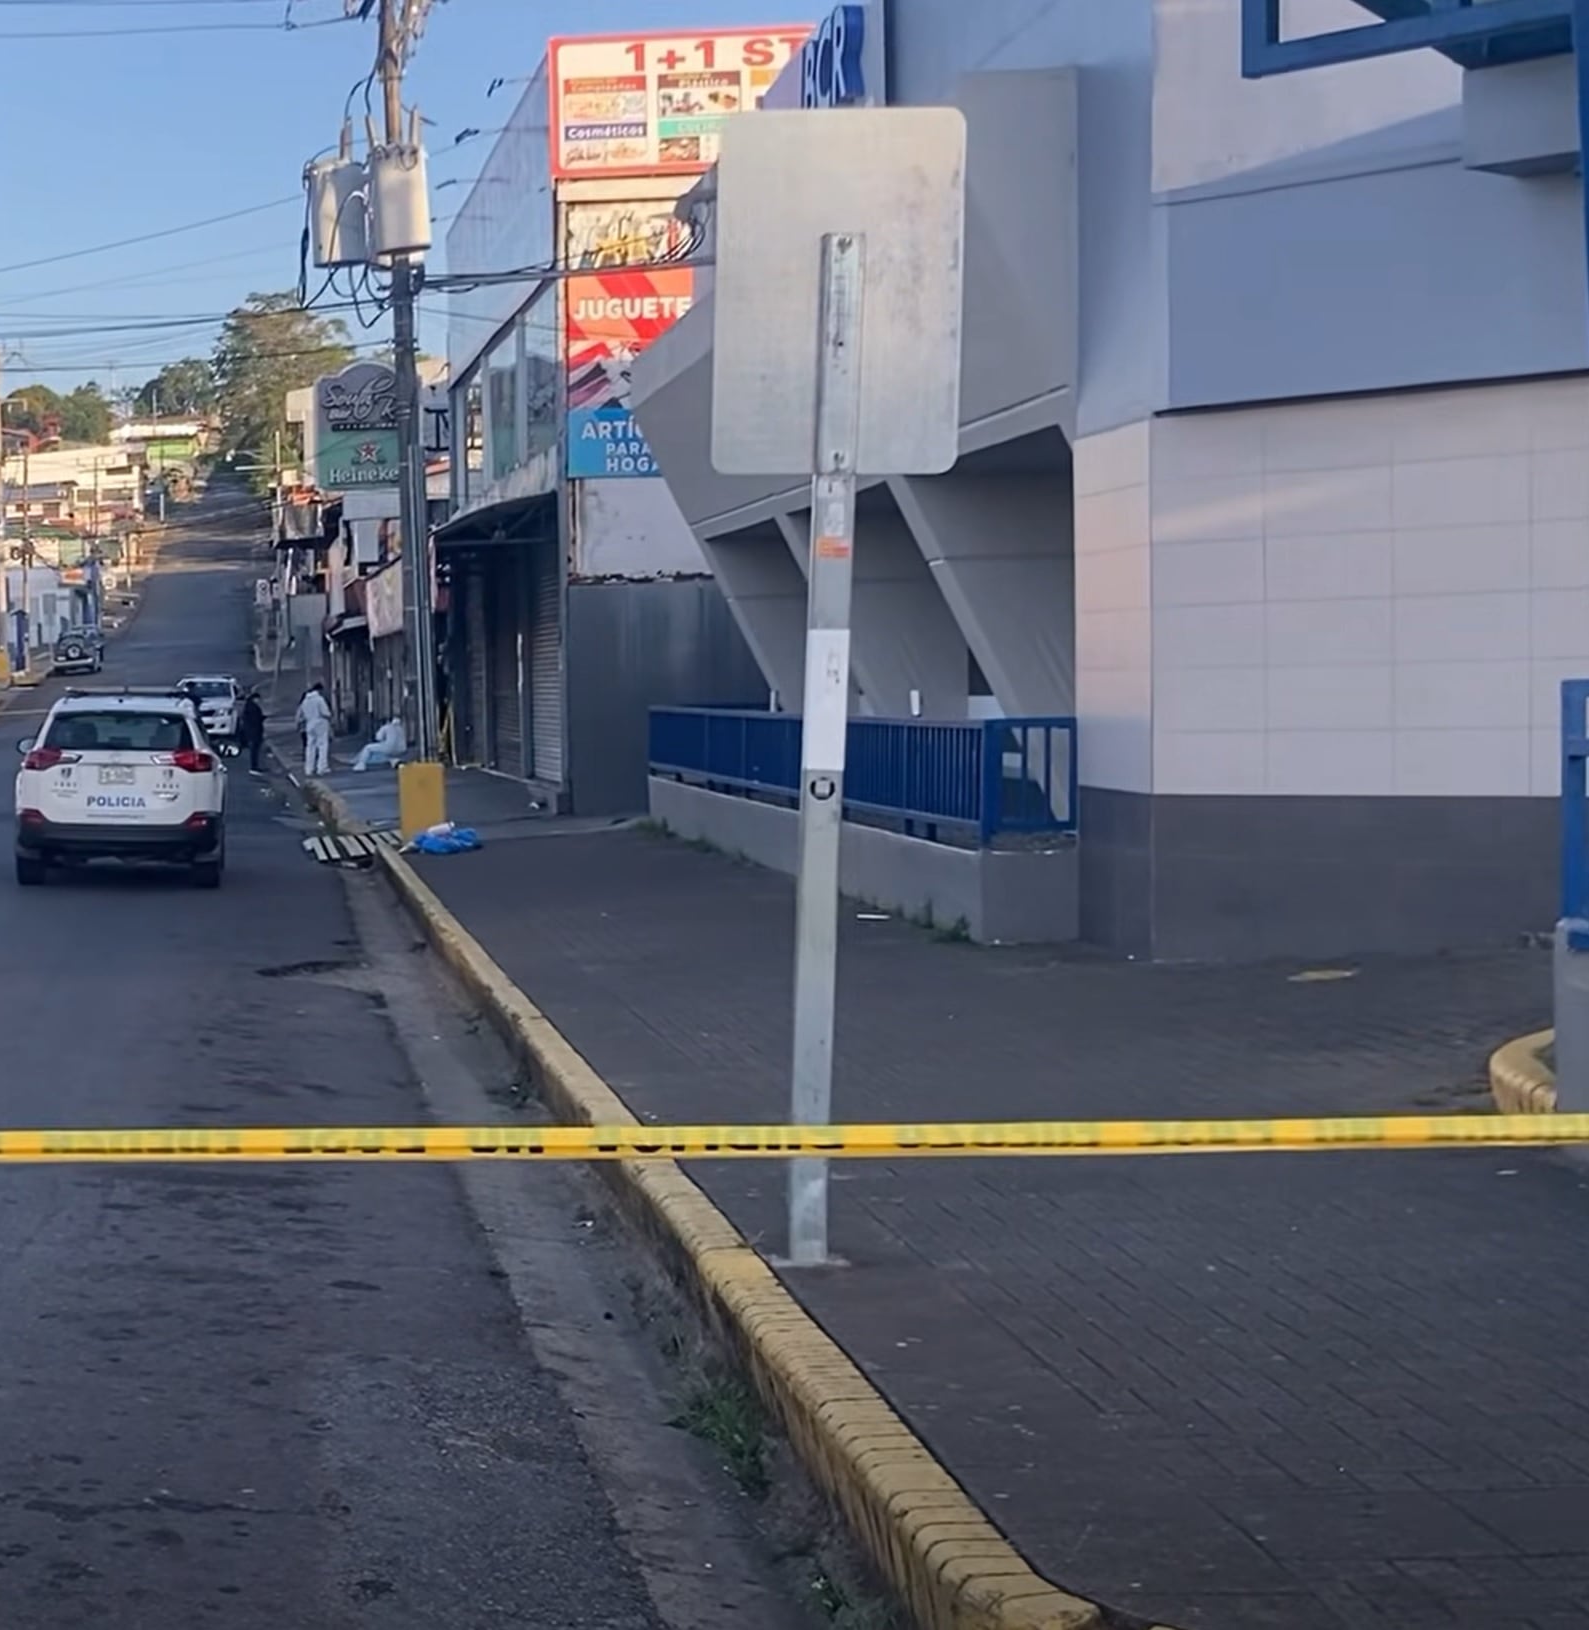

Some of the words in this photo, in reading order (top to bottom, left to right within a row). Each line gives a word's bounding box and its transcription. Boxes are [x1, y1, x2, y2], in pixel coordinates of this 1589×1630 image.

[625, 40, 715, 71] 1+1
[804, 5, 847, 109] BCR
[567, 125, 645, 139] Cosméticos
[605, 443, 652, 456] PARA
[86, 796, 146, 808] POLICIA
